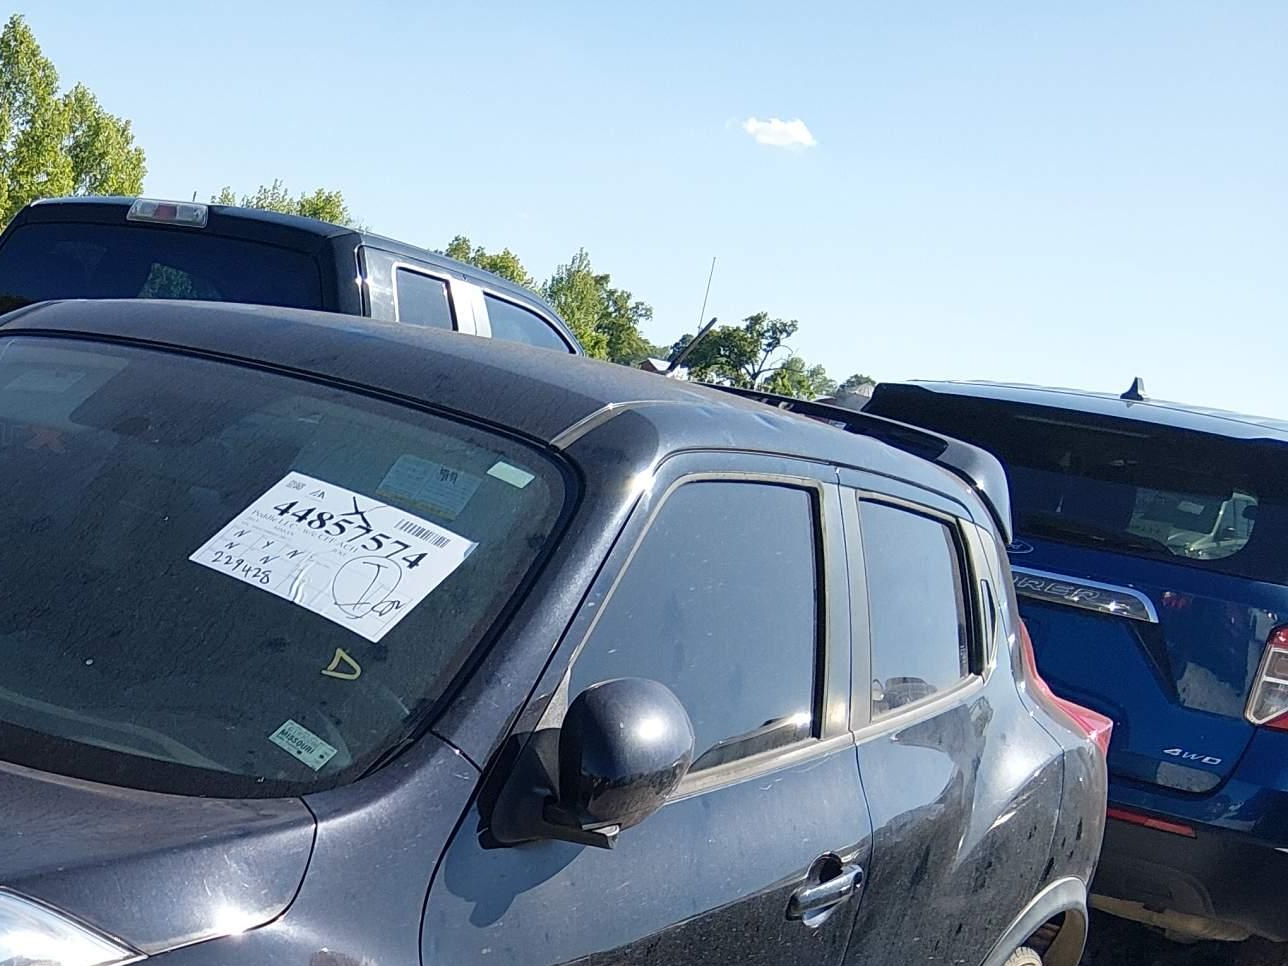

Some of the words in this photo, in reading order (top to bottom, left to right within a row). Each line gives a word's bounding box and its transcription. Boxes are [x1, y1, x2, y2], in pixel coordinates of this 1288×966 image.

[273, 500, 429, 570] 44857574
[211, 550, 273, 585] 229428
[278, 728, 316, 755] MISSOURI
[1162, 747, 1223, 766] 4WD
